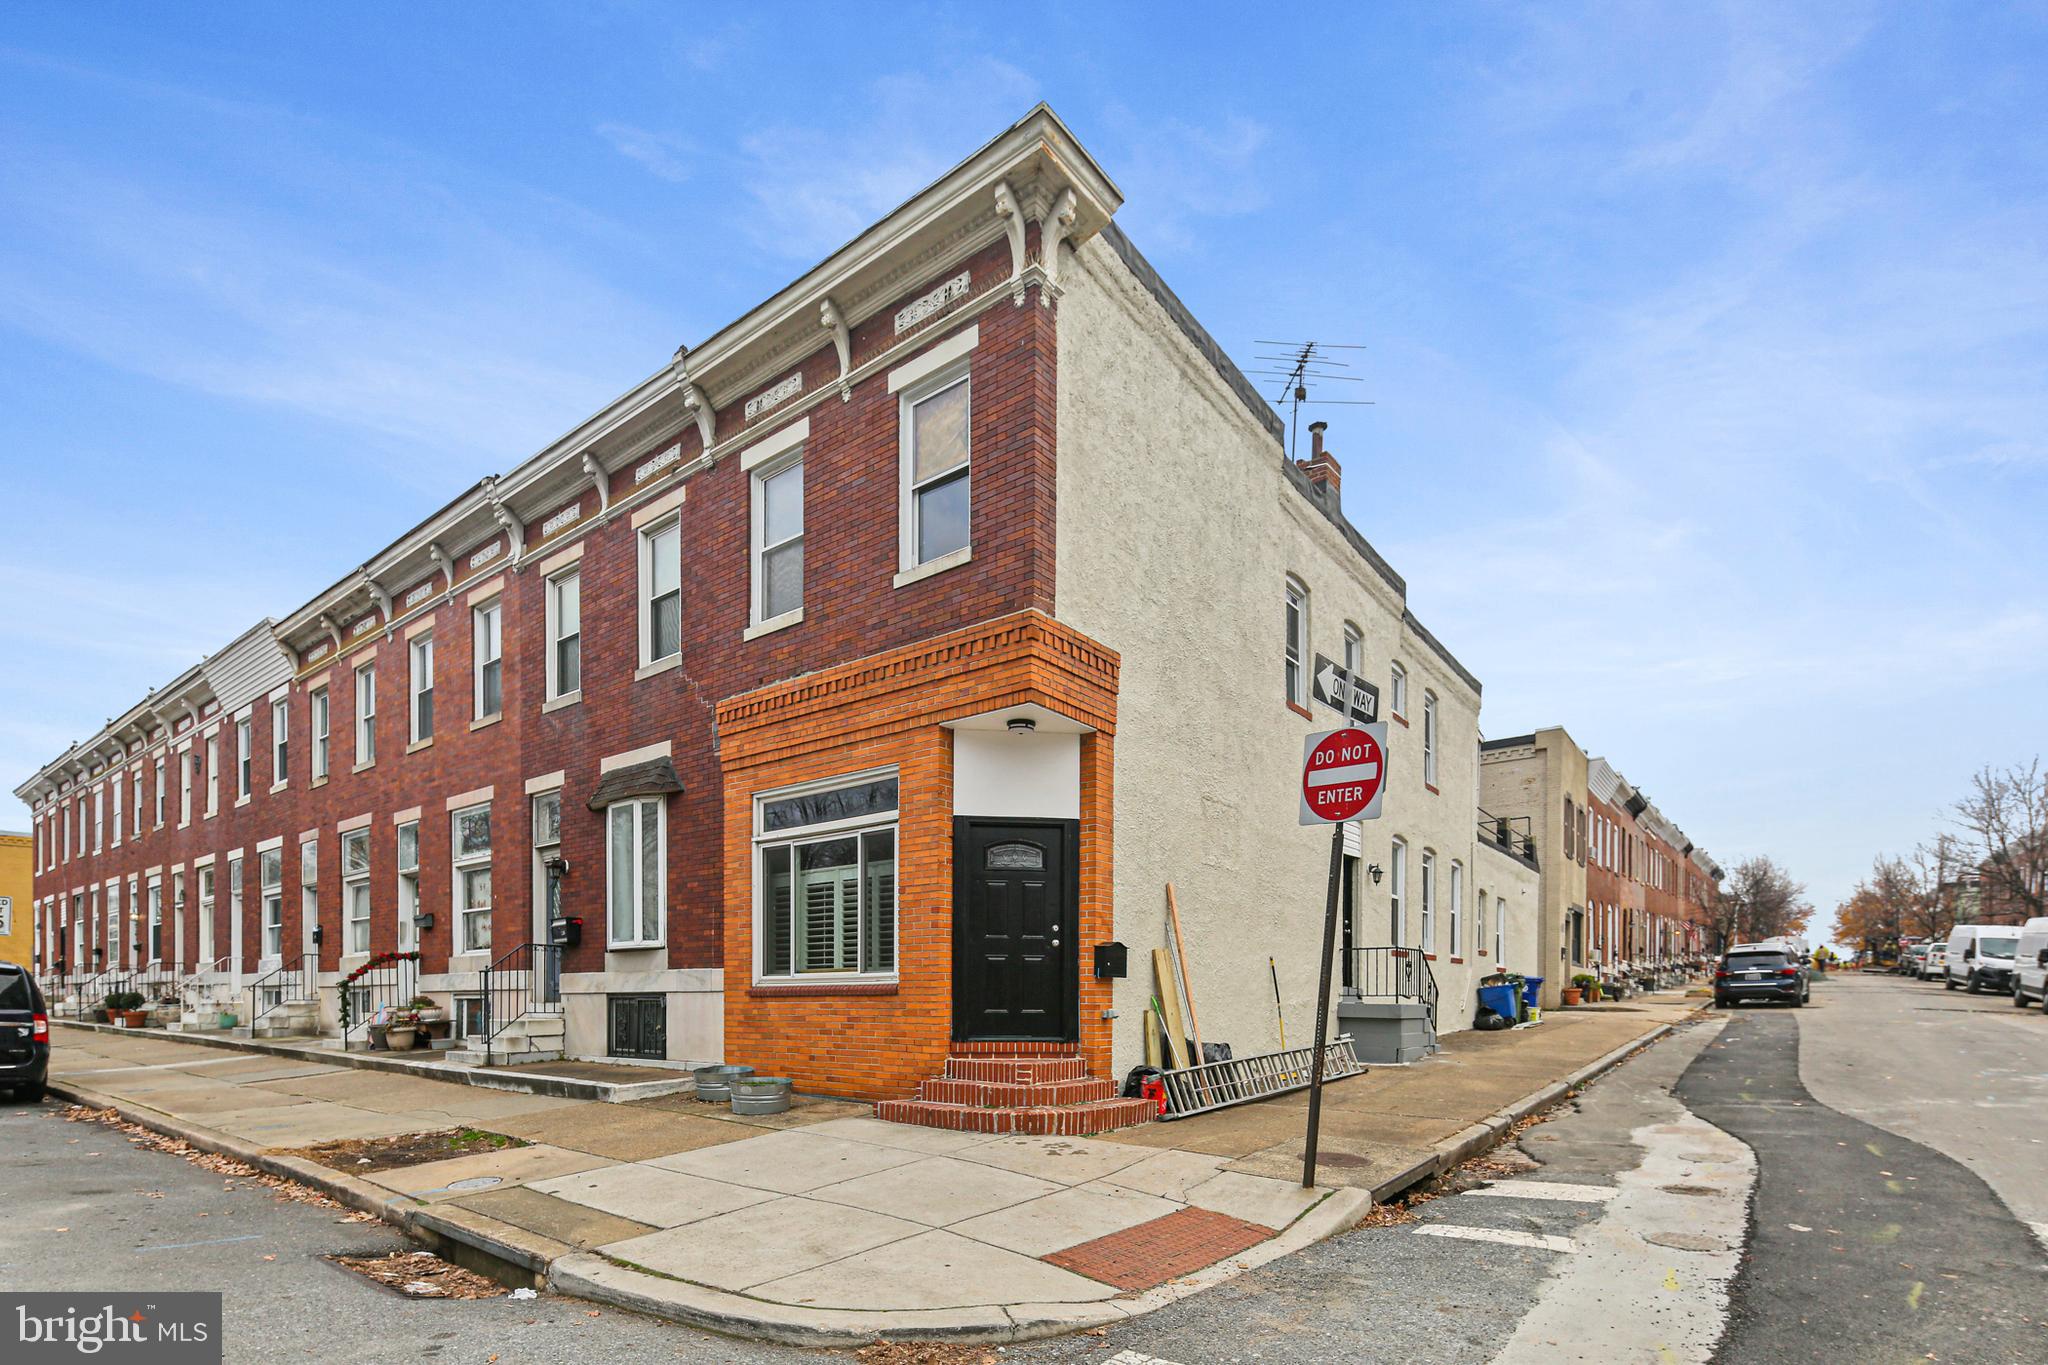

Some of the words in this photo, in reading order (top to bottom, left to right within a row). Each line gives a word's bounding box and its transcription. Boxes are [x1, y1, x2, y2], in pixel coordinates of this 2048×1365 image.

[1333, 678, 1349, 702] ON
[1353, 689, 1372, 712] WAY
[1315, 750, 1335, 765] DO
[1341, 744, 1372, 761] NOT
[1318, 787, 1363, 804] ENTER
